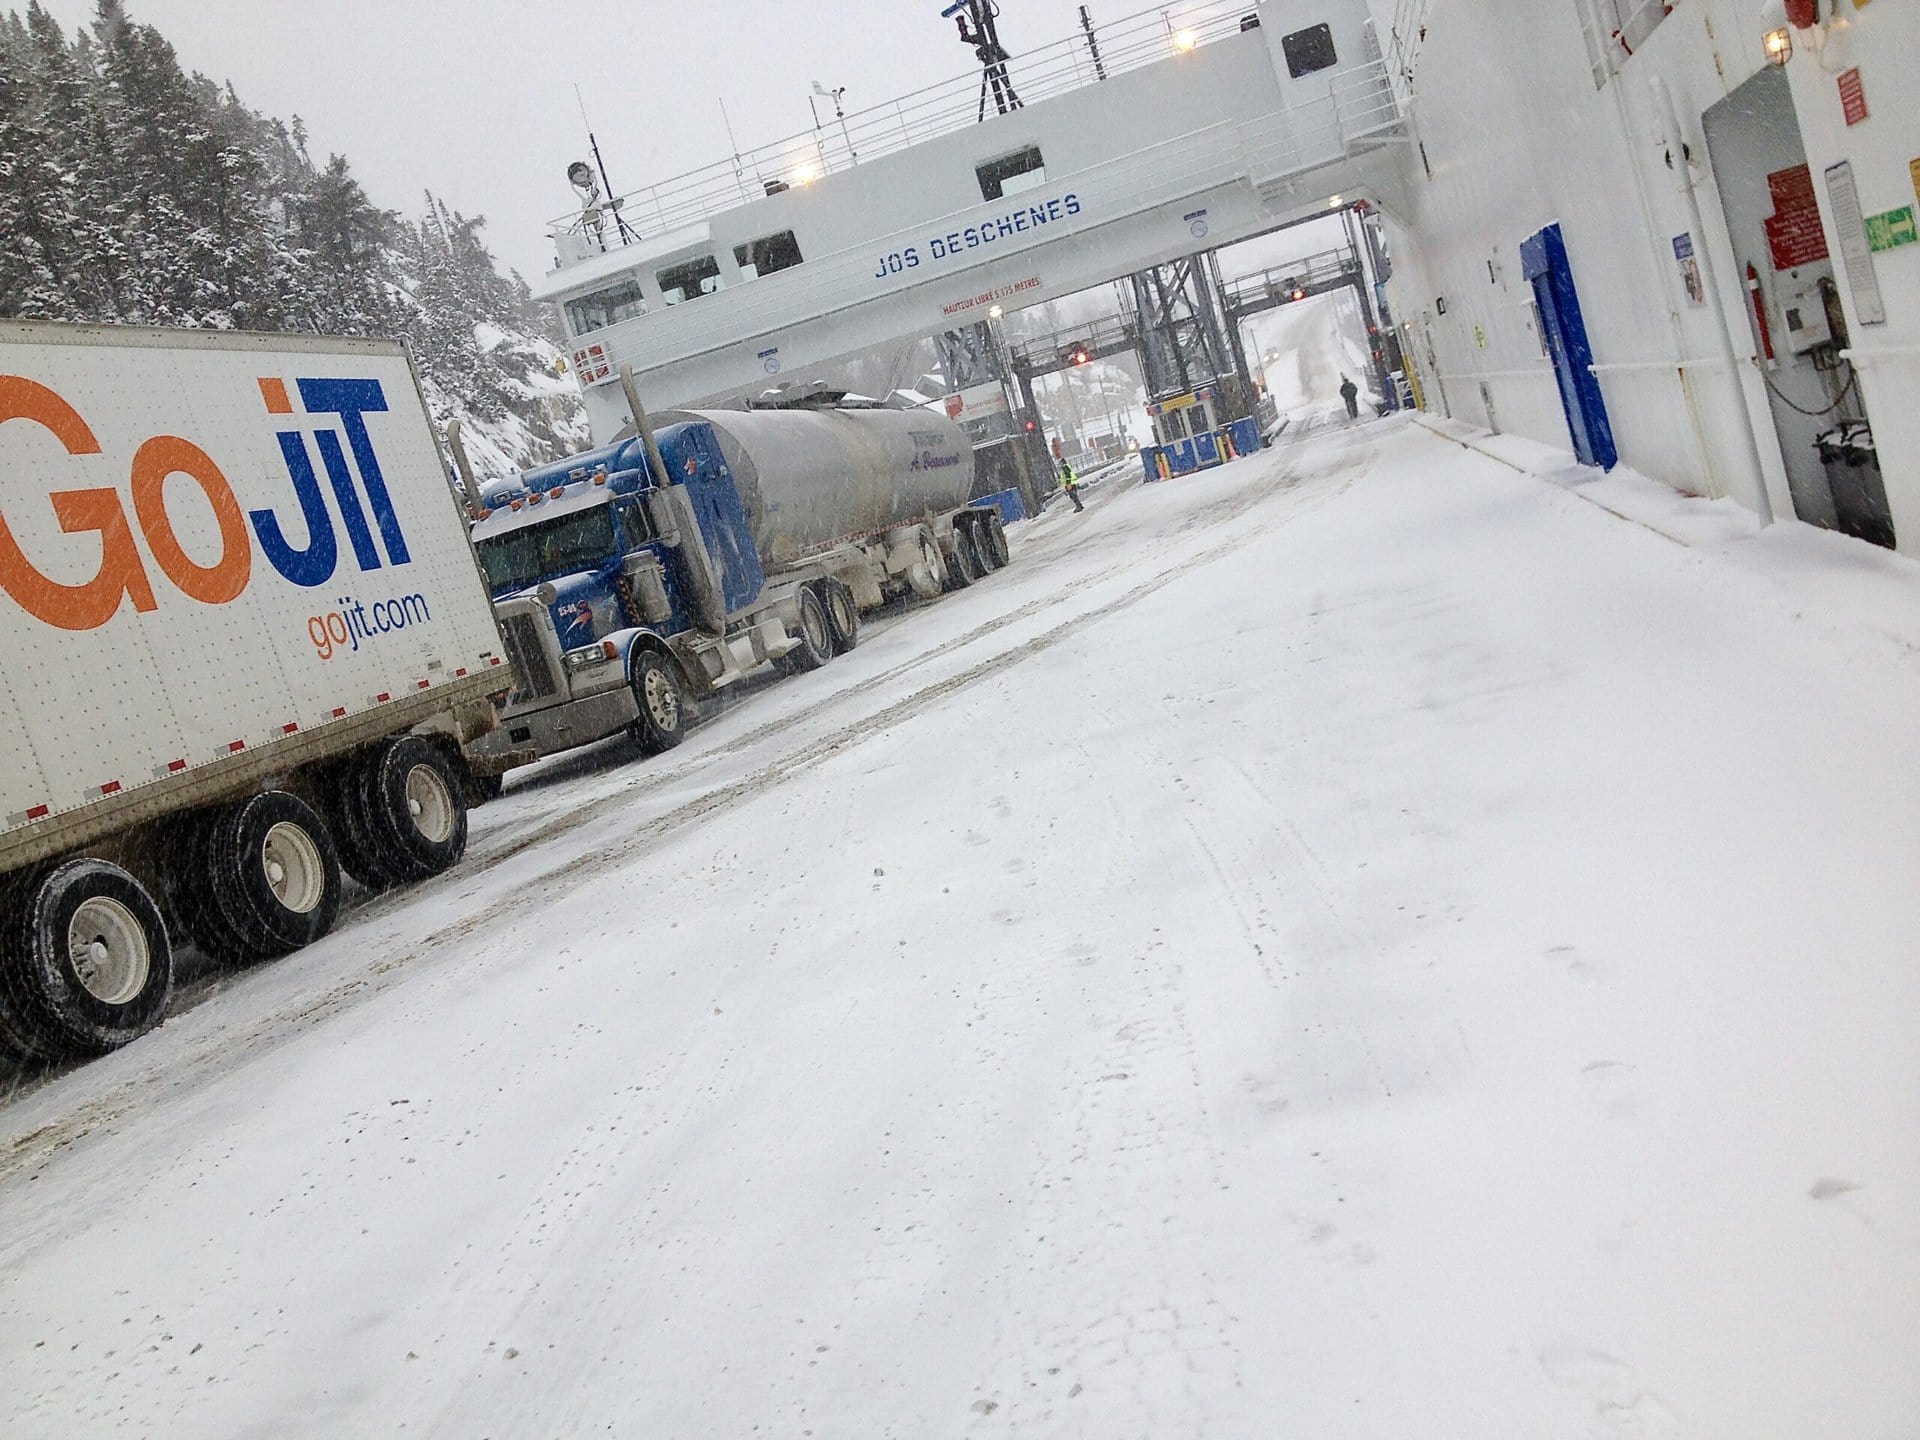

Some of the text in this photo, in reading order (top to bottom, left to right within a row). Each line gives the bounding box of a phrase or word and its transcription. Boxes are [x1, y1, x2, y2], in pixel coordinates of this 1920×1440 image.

[874, 193, 1081, 279] JOS DESCHENES
[942, 298, 975, 315] HAUTEUR
[975, 291, 994, 305] LIBRE
[307, 593, 431, 660] gojit.com
